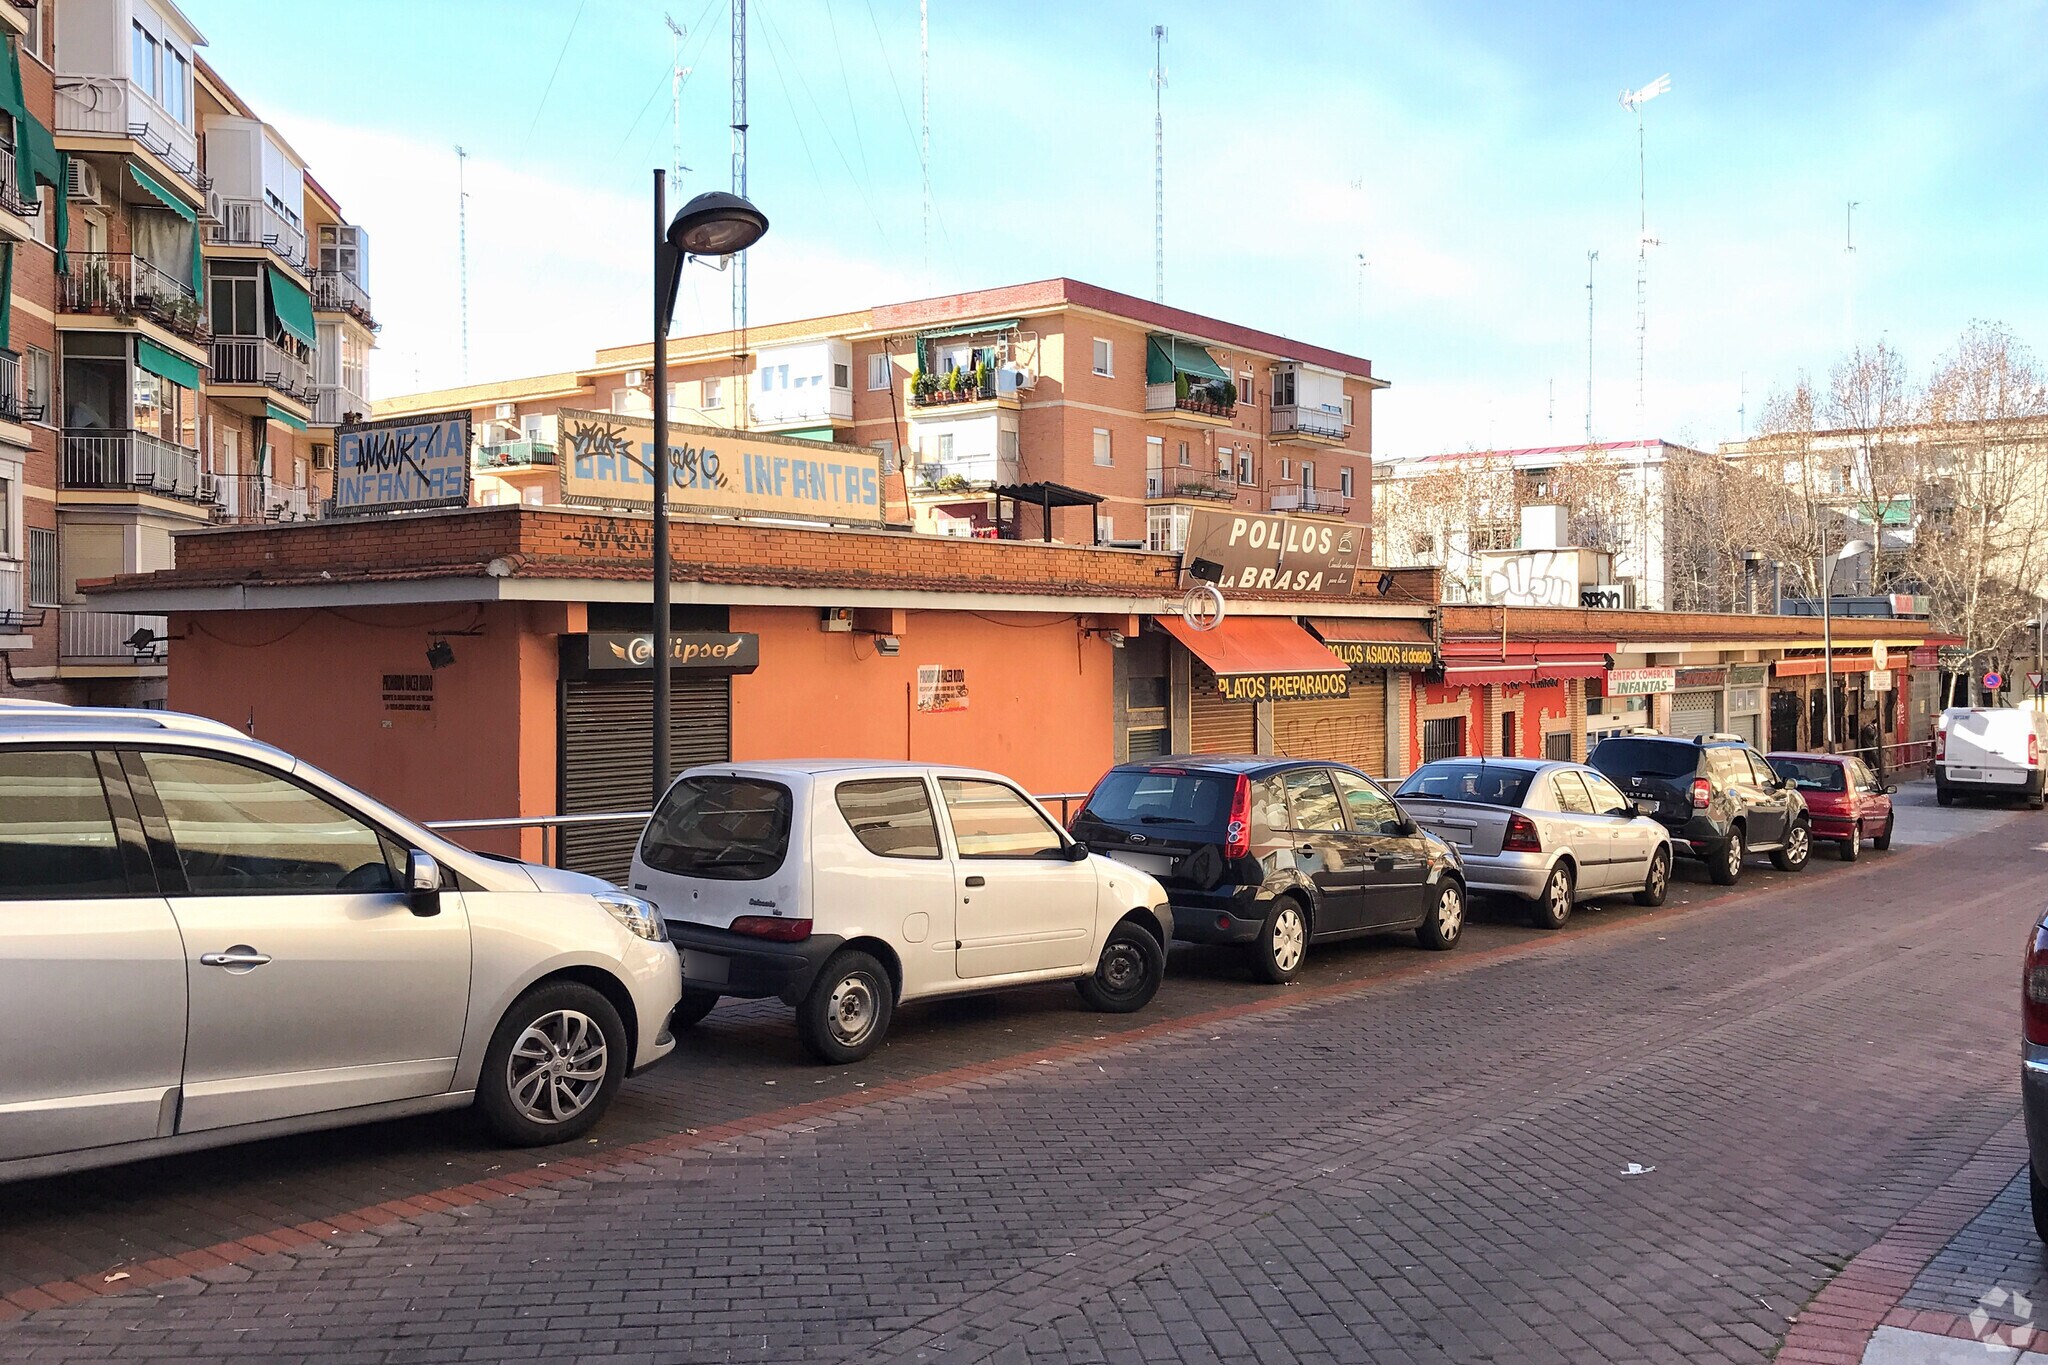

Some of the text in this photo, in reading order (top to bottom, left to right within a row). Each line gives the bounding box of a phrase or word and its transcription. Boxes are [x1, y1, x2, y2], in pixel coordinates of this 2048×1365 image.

[339, 466, 462, 505] INFANTAS
[743, 453, 877, 505] INFANTAS
[1228, 518, 1332, 554] POLLOS
[1238, 566, 1324, 592] BRASA
[1366, 645, 1400, 664] ASADOS
[1218, 674, 1347, 699] PLATOS PREPARADOS
[1608, 670, 1637, 681] CENTRO
[1639, 669, 1674, 680] COMERCIAL
[1617, 680, 1668, 694] INFANTAS
